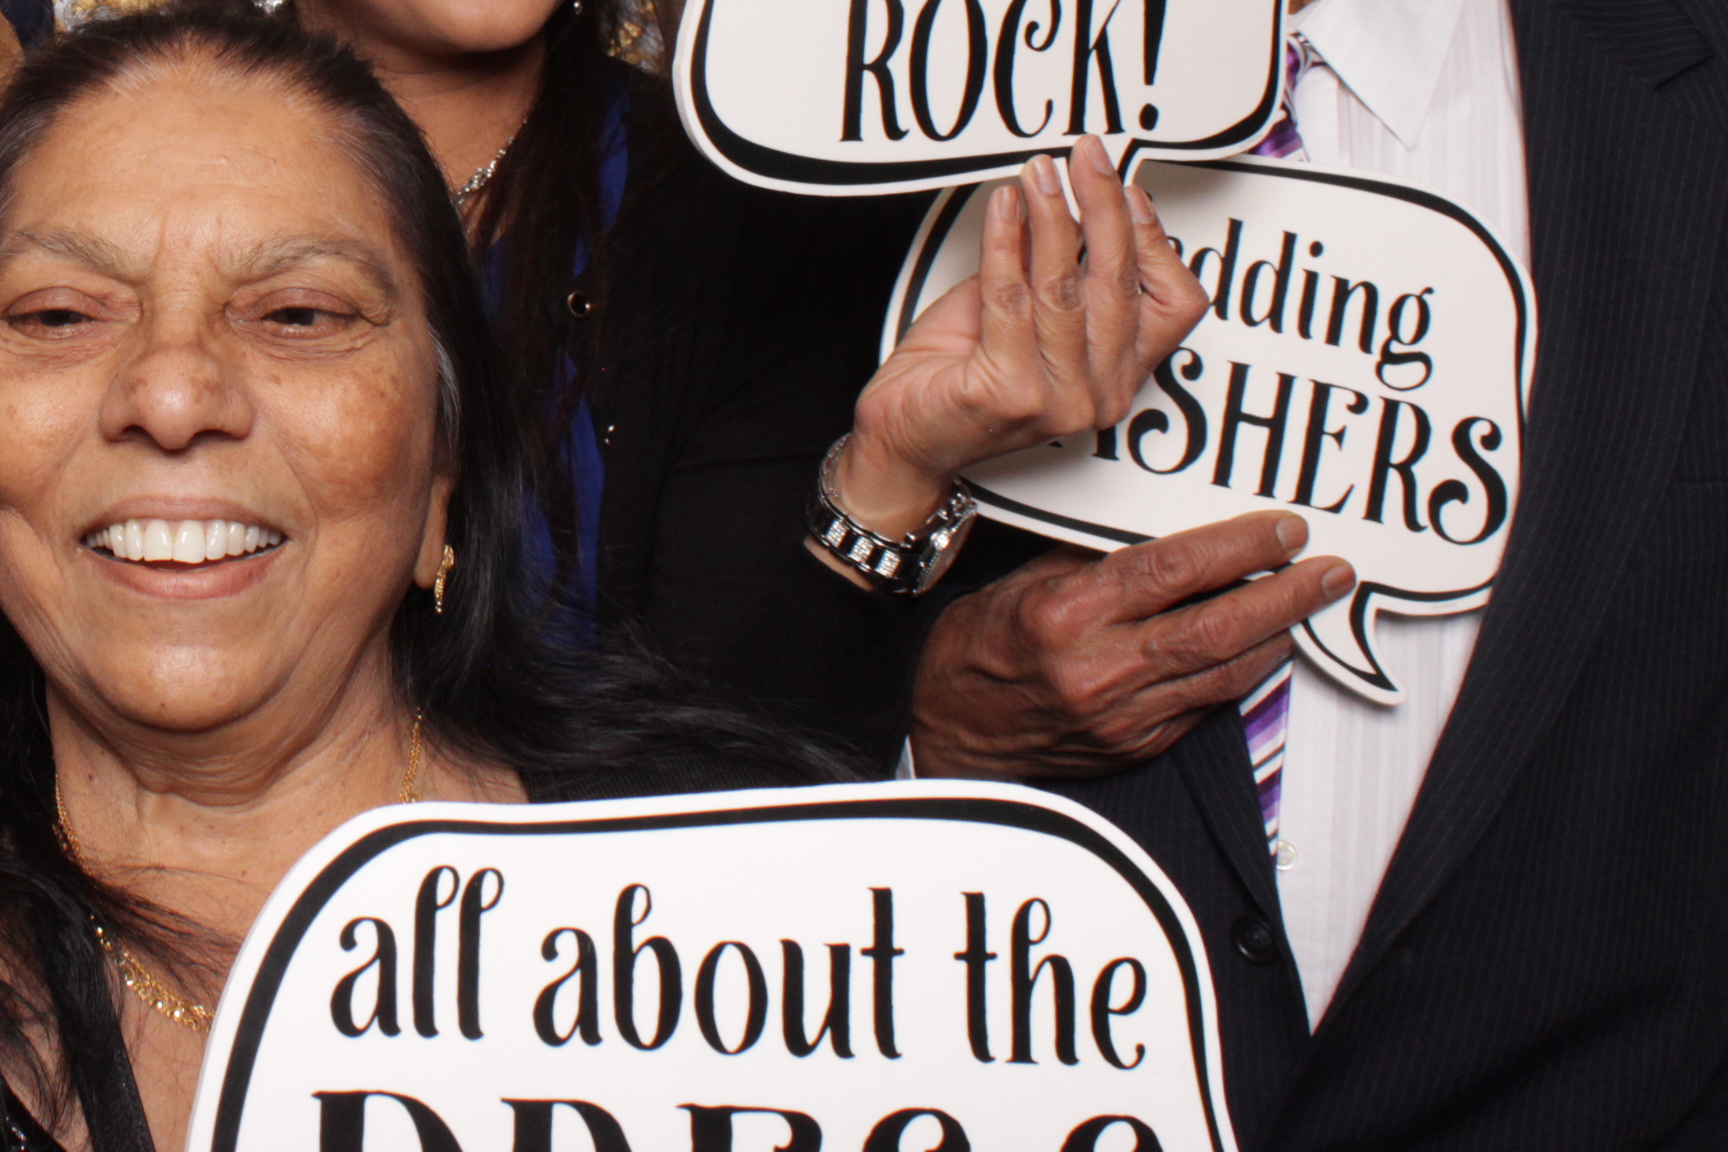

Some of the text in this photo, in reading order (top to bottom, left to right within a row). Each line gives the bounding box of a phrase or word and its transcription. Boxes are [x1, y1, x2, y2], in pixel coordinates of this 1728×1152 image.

[1165, 215, 1435, 393] dding
[1047, 345, 1509, 547] SHERS
[329, 864, 1148, 1071] all about the
